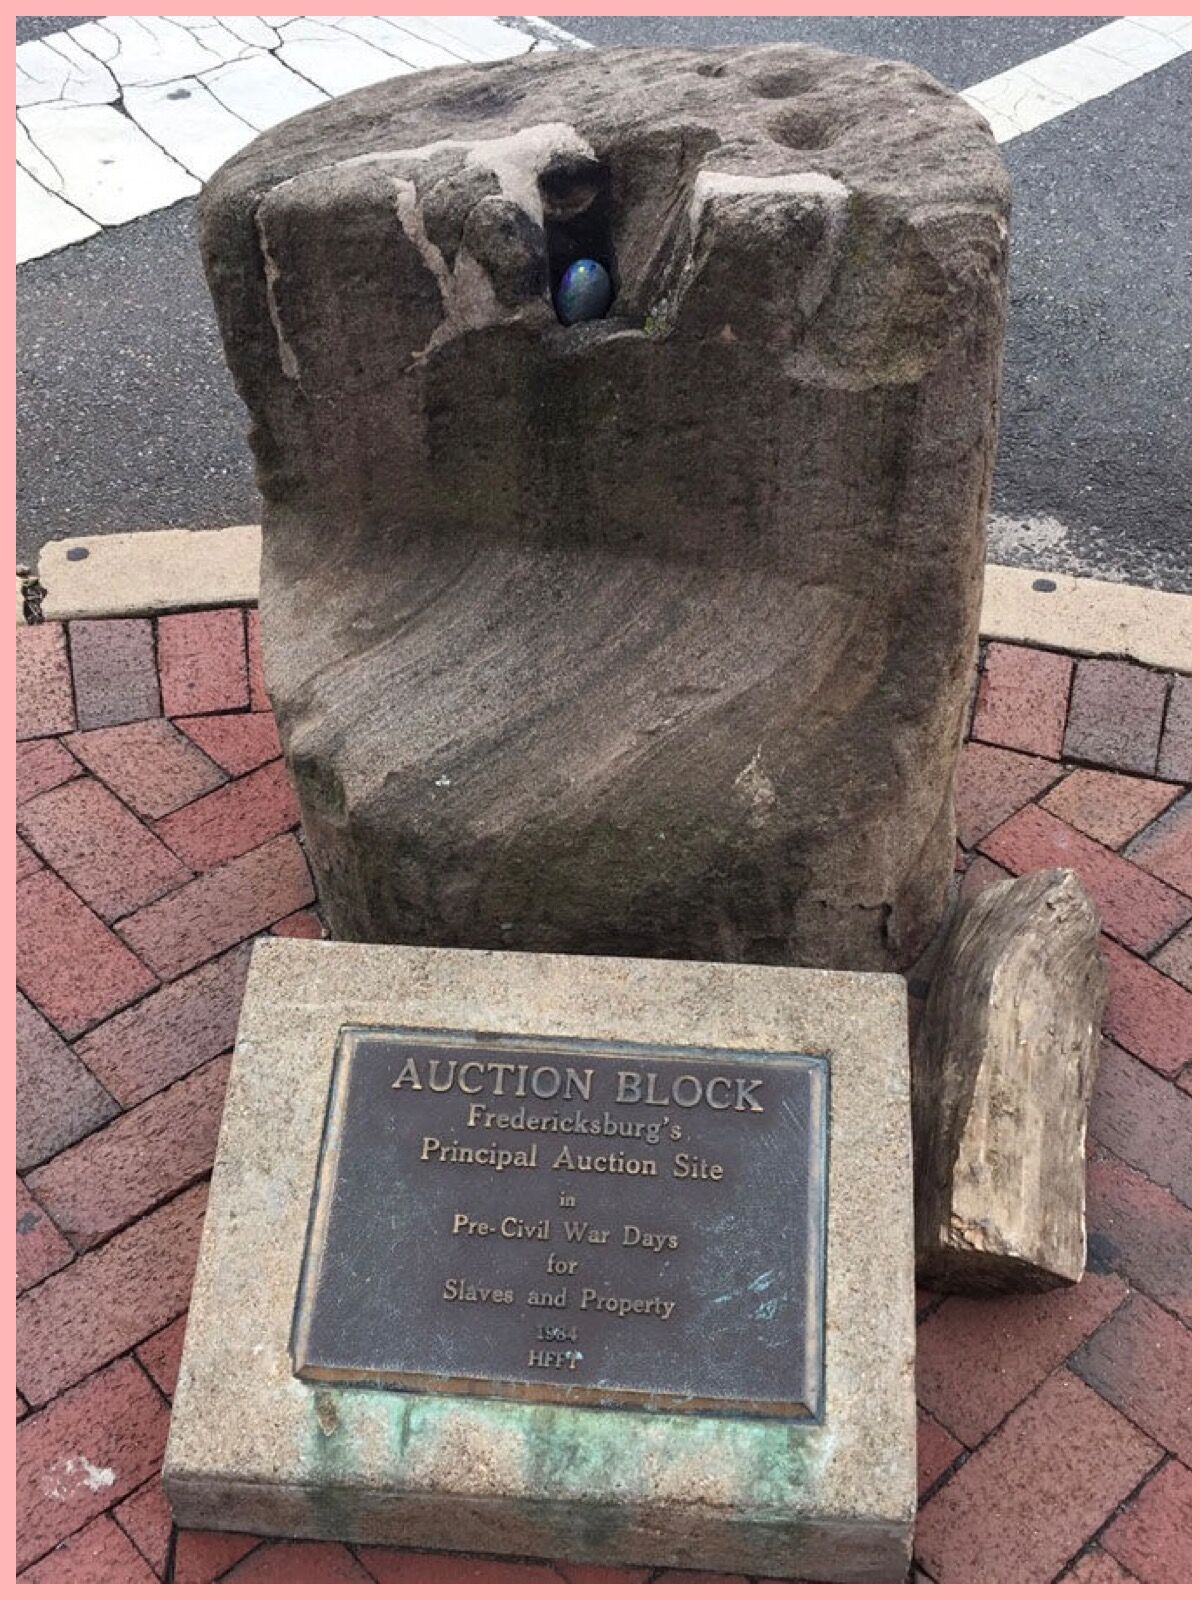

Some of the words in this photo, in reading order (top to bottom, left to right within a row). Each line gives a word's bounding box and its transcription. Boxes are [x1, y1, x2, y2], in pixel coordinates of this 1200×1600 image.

[391, 1057, 594, 1101] AUCTION
[616, 1071, 764, 1112] BLOCK
[466, 1103, 683, 1144] Fredericksburg's
[420, 1137, 537, 1170] Principal
[552, 1145, 657, 1176] Auction
[673, 1153, 725, 1181] Site
[559, 1191, 576, 1208] in
[564, 1221, 611, 1245] War
[622, 1224, 679, 1251] Days
[547, 1252, 578, 1275] for
[442, 1278, 514, 1304] Slaves
[527, 1287, 567, 1308] and
[579, 1288, 676, 1320] Property
